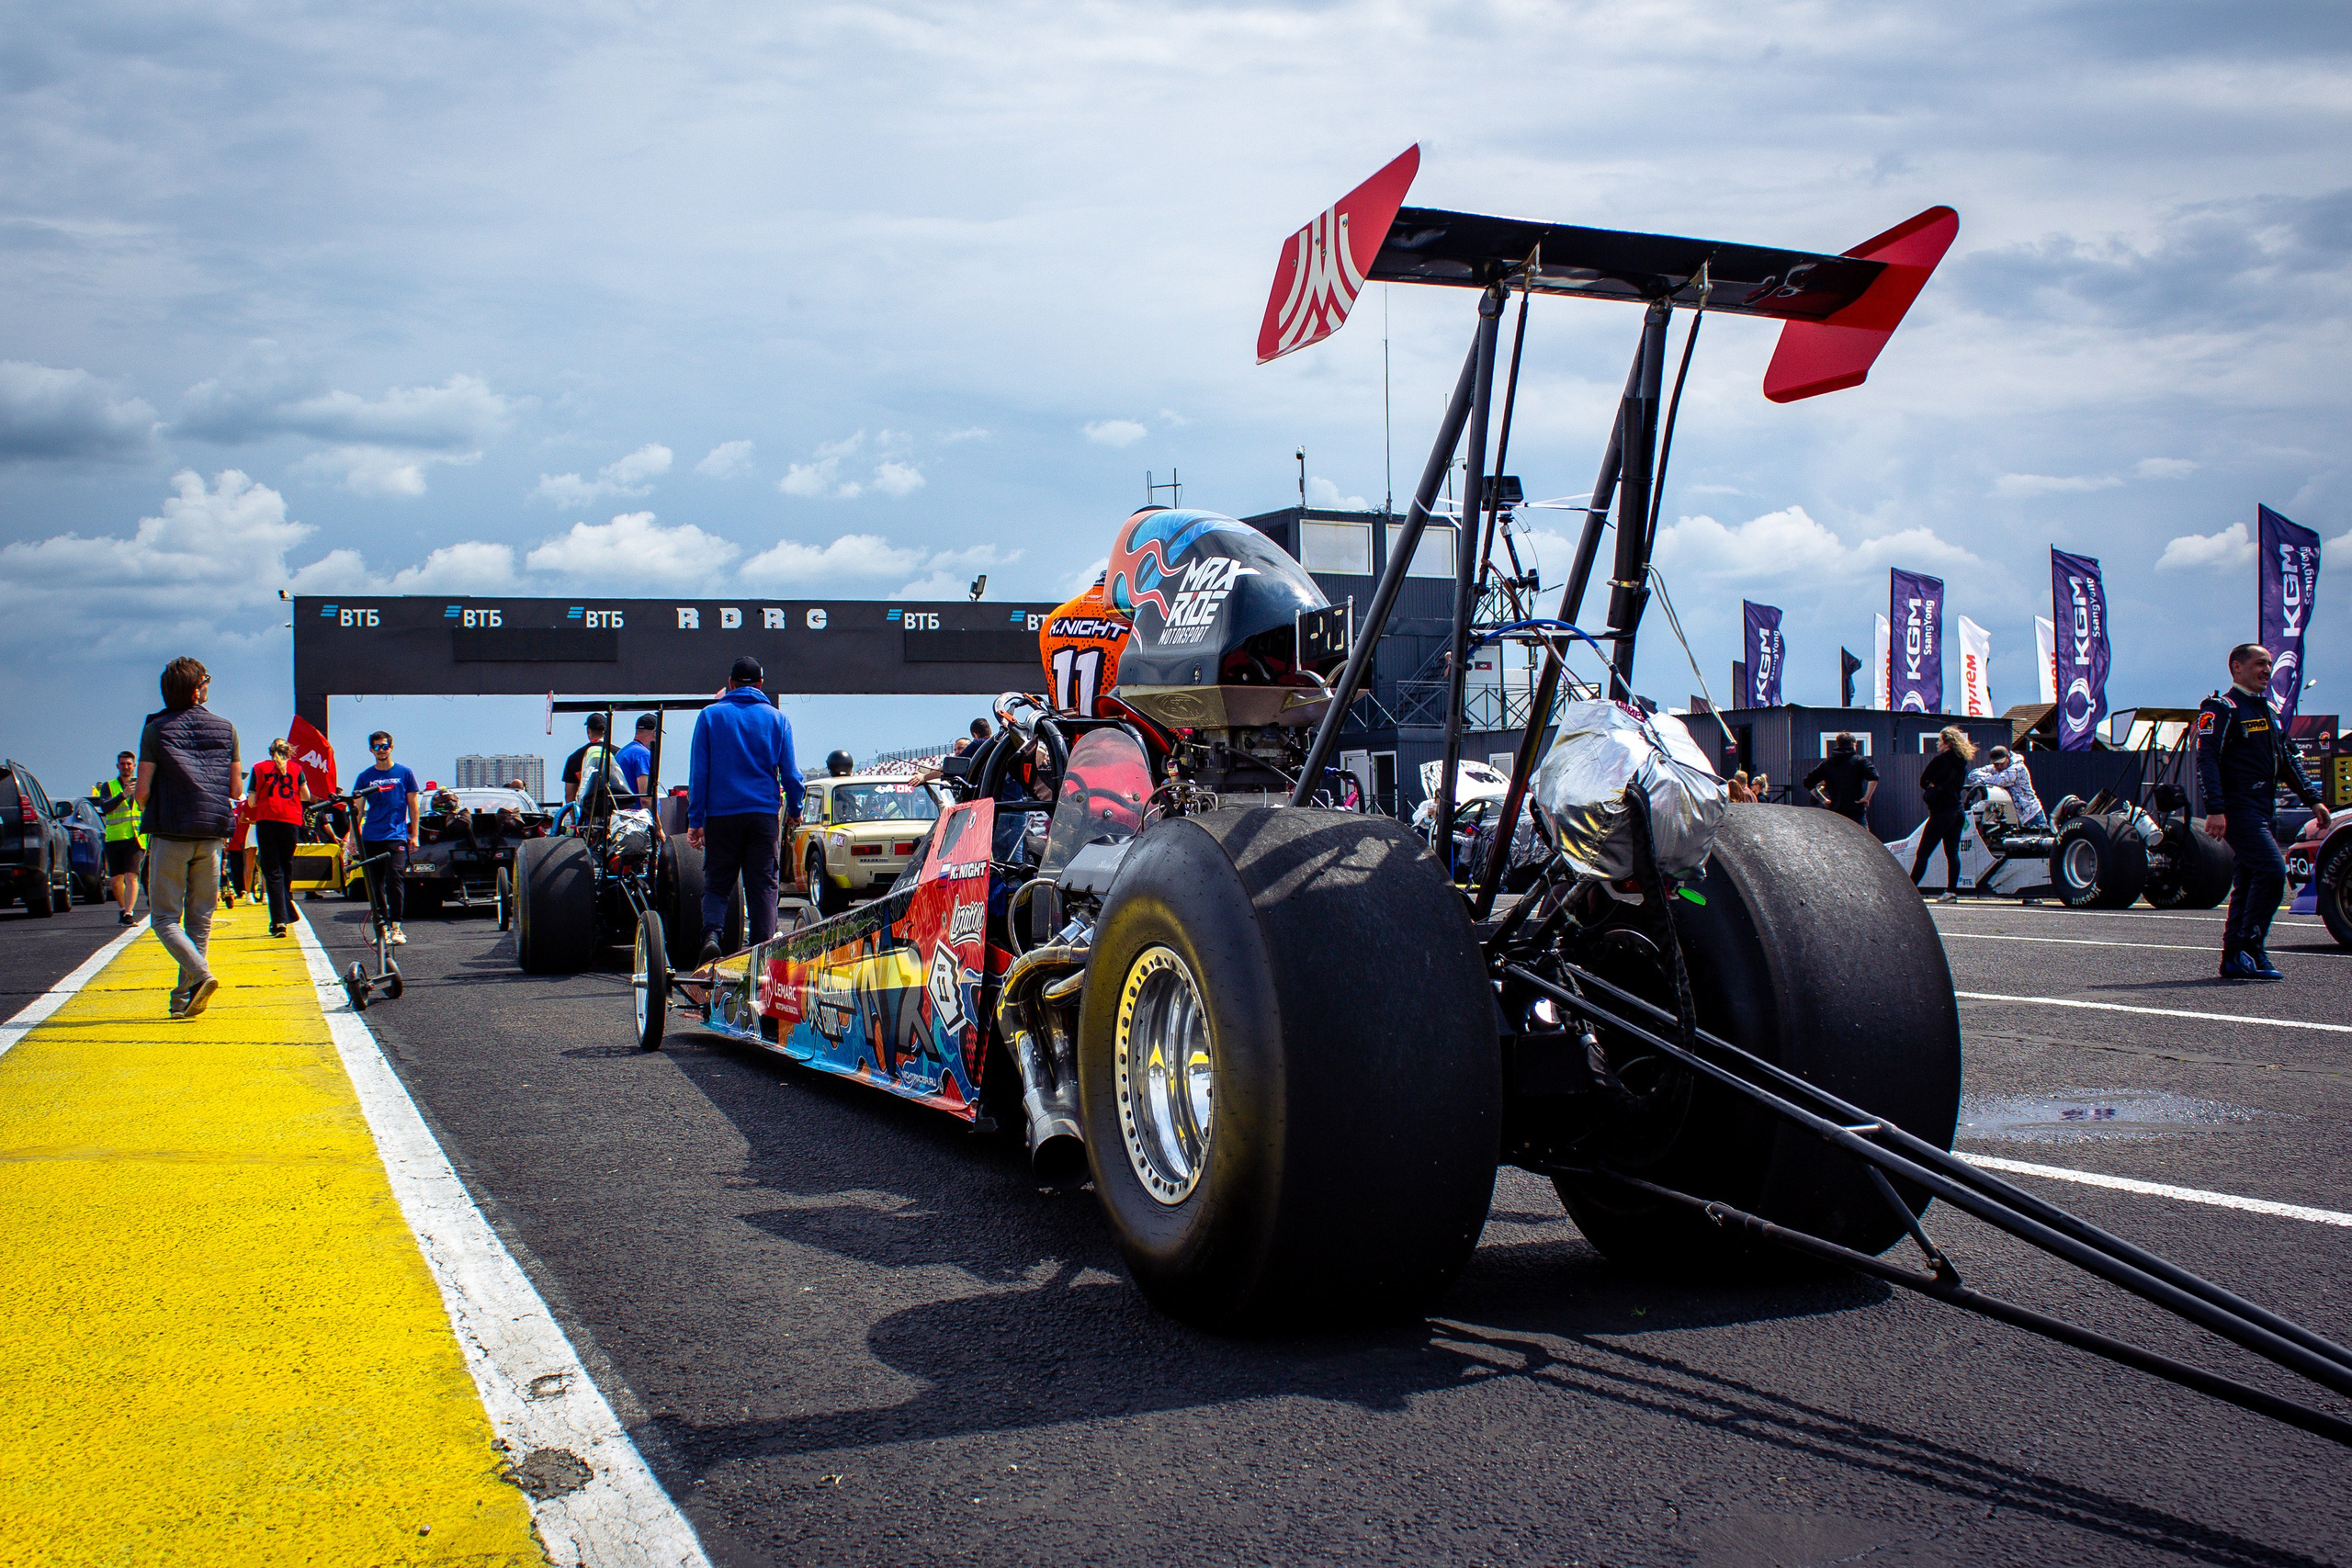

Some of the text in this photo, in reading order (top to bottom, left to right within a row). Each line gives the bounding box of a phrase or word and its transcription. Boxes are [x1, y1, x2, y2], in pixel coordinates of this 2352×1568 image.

[2301, 546, 2315, 605] SsangYong
[2279, 544, 2301, 637] KGM
[339, 608, 380, 627] ВТБ
[463, 608, 503, 627] ВТБ
[585, 610, 624, 628] ВТБ
[1165, 590, 1229, 627] RIDE
[2086, 577, 2101, 637] SsangYong
[904, 613, 940, 630] ВТБ
[1027, 614, 1050, 631] ВТ
[1049, 619, 1128, 638] K.NIGHT
[1923, 600, 1935, 656] SsangYong
[2068, 575, 2090, 666] KGM
[1158, 626, 1210, 646] MOTORSPORT
[1905, 598, 1922, 681] KGM
[1756, 627, 1772, 702] KGM
[1053, 649, 1100, 717] 11
[265, 773, 294, 799] 78
[2055, 821, 2083, 845] Hoosier
[959, 862, 987, 878] NIGHT
[2072, 883, 2102, 906] Hoosier
[774, 978, 797, 1001] LEMARC
[936, 976, 950, 1003] 11
